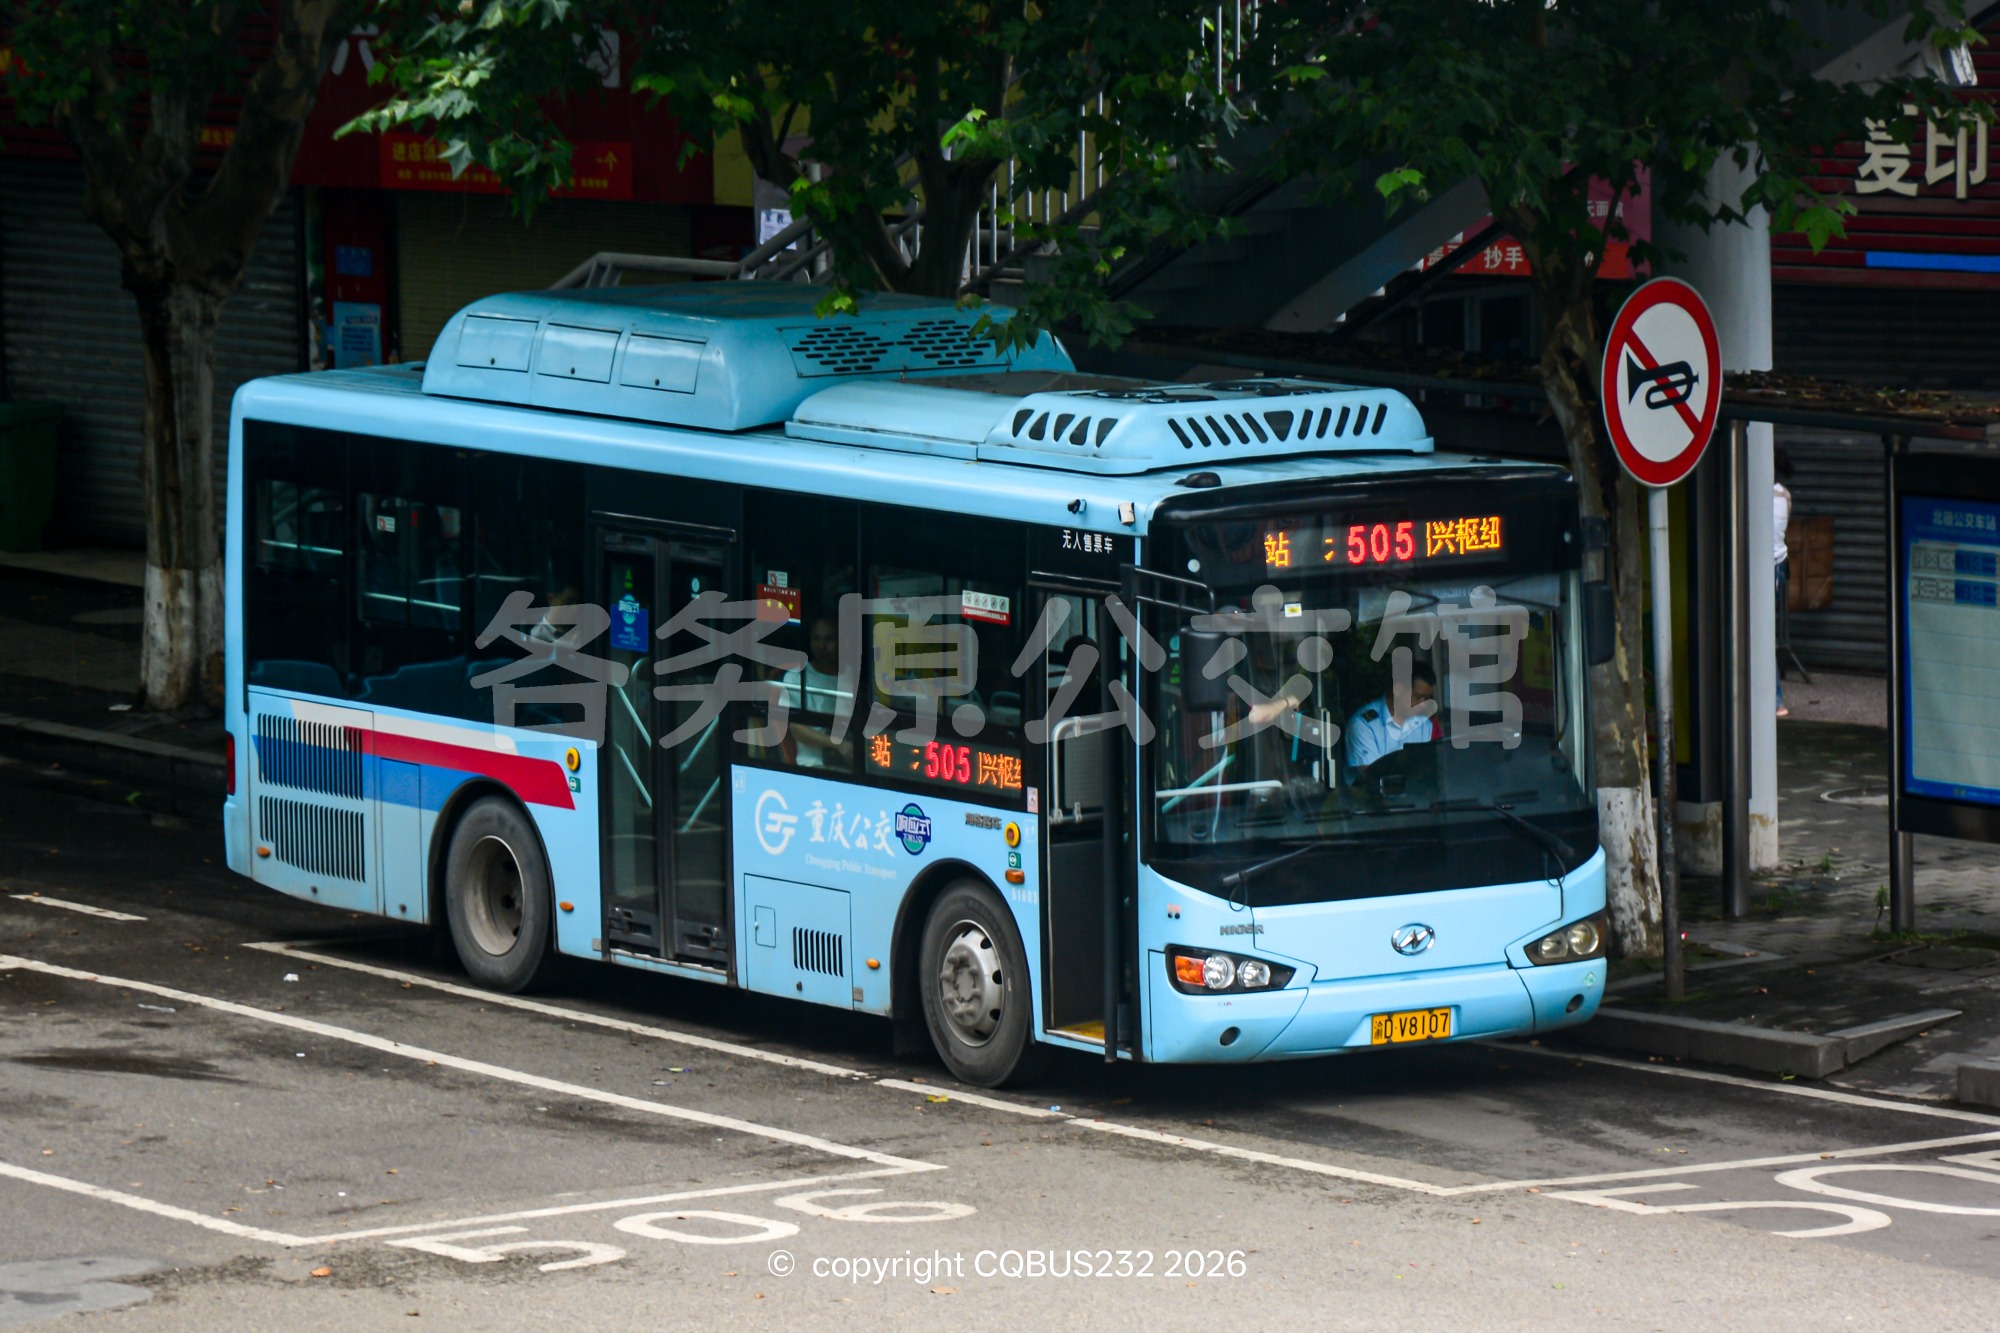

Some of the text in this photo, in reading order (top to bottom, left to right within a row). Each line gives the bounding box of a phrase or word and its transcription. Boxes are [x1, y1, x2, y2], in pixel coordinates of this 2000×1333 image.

[1483, 245, 1524, 270] 抄手
[1062, 529, 1114, 555] 无人售票车
[1264, 532, 1289, 567] 站
[1346, 521, 1415, 565] 505
[925, 741, 971, 784] 505
[805, 799, 896, 858] 重庆公交
[896, 813, 932, 838] 响应式
[842, 859, 863, 874] Public
[865, 863, 897, 880] Transport
[1219, 923, 1265, 936] HIGER
[1540, 1148, 2000, 1239] 50
[385, 1187, 978, 1272] 506
